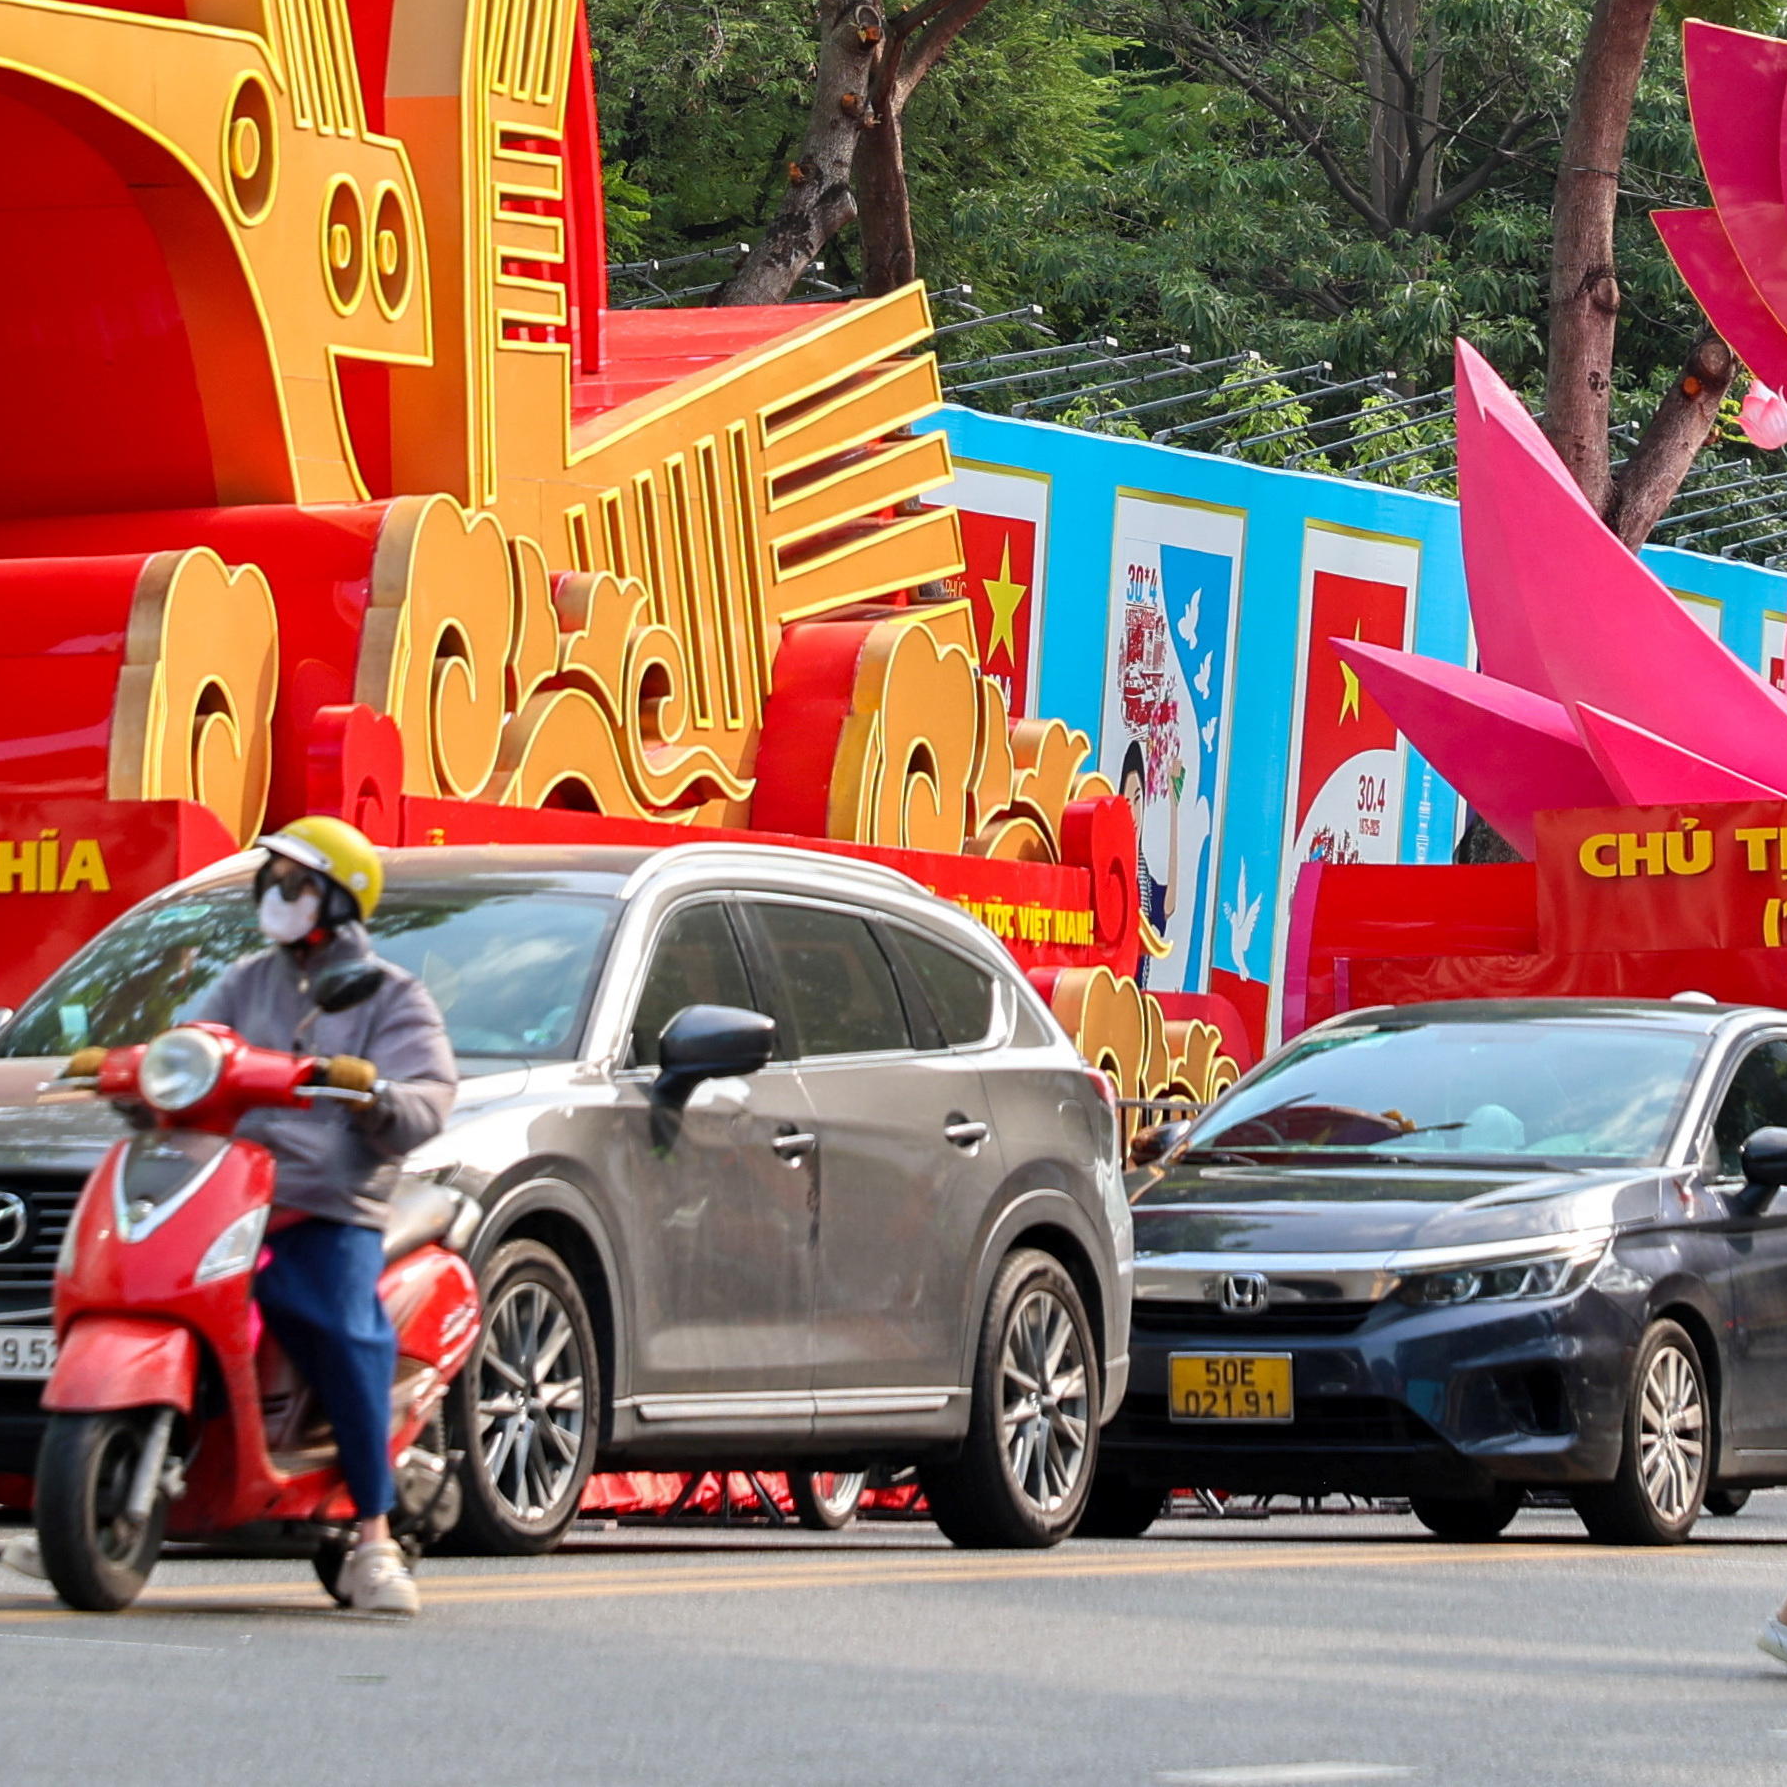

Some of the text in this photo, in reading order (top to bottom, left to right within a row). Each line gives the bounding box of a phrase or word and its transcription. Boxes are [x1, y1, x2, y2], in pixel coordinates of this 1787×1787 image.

[1357, 774, 1385, 813] 30.4
[1578, 817, 1713, 878] CHỦ
[1018, 901, 1051, 947] VIỆT
[1055, 909, 1095, 946] NAM!
[1205, 1359, 1255, 1386] 50E
[1185, 1390, 1275, 1418] 021.91
